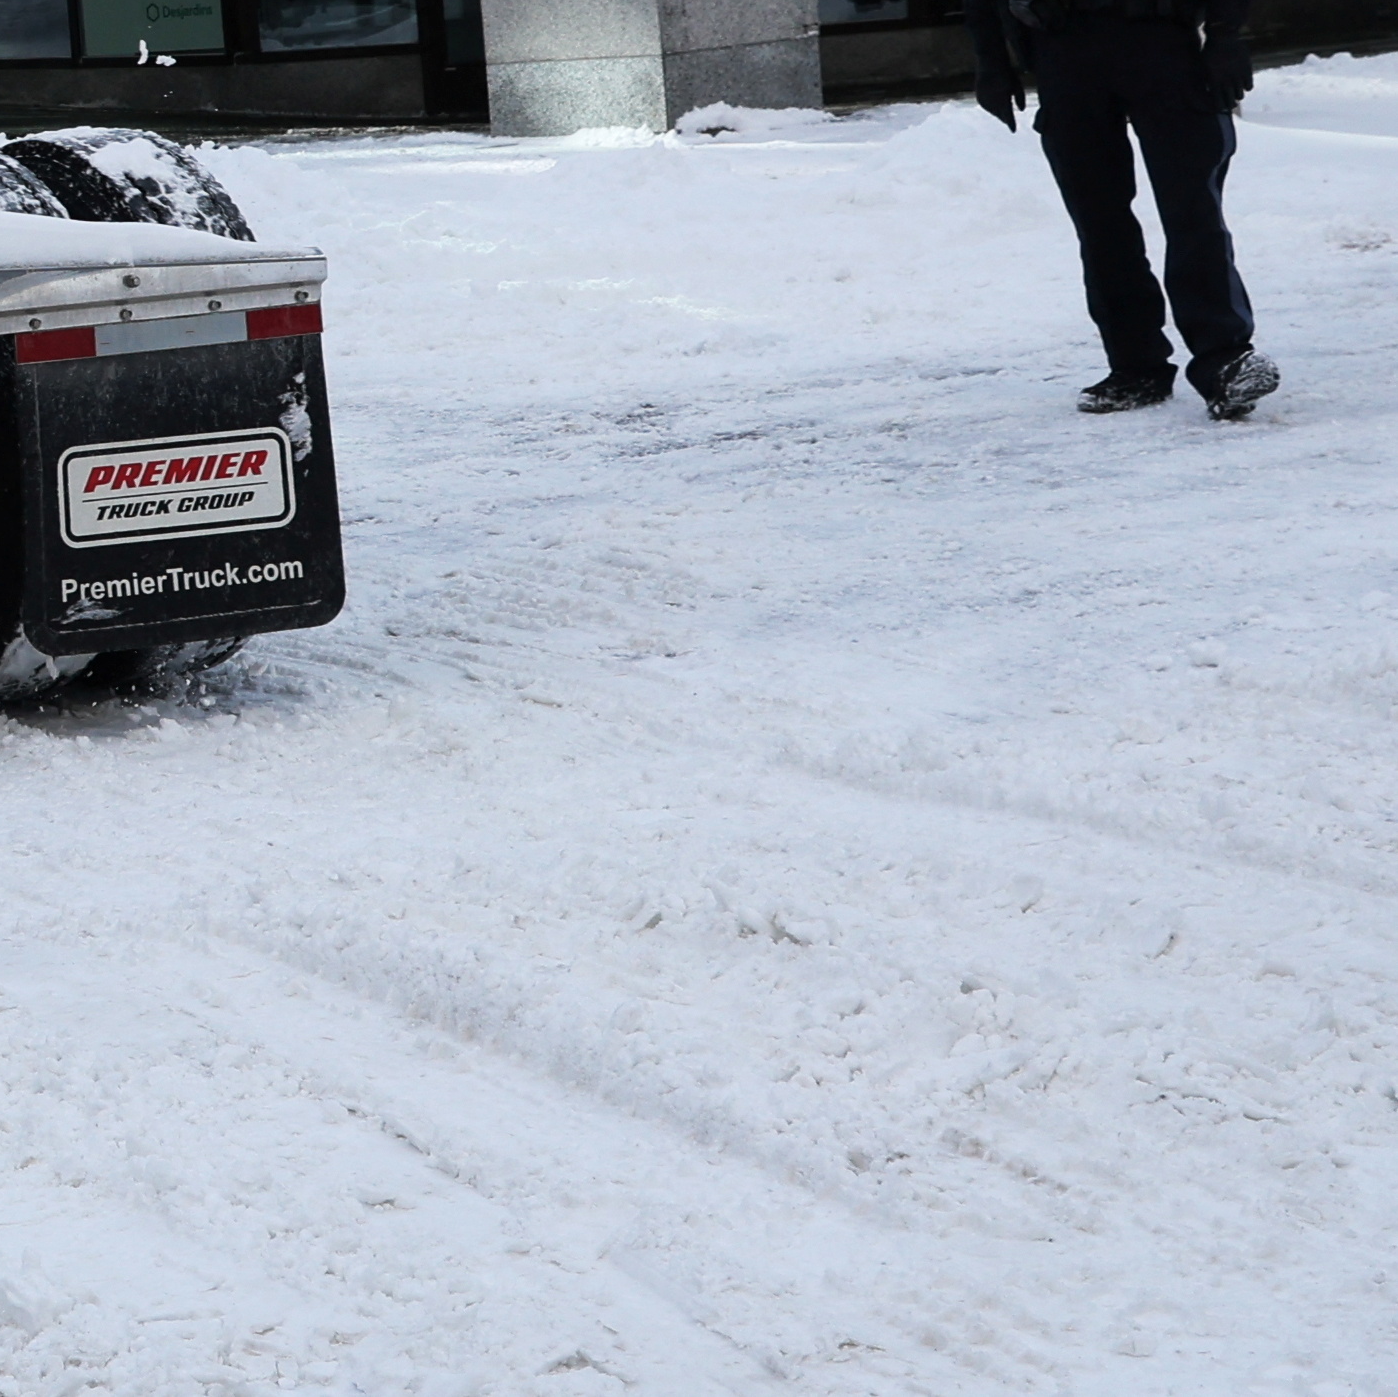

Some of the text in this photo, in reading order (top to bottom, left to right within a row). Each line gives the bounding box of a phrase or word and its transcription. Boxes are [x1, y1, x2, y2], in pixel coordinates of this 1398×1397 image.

[162, 3, 213, 21] Desjardins
[82, 449, 269, 494] PREMIER
[96, 491, 255, 521] TRUCK GROUP
[61, 559, 304, 603] PremierTruck.com
